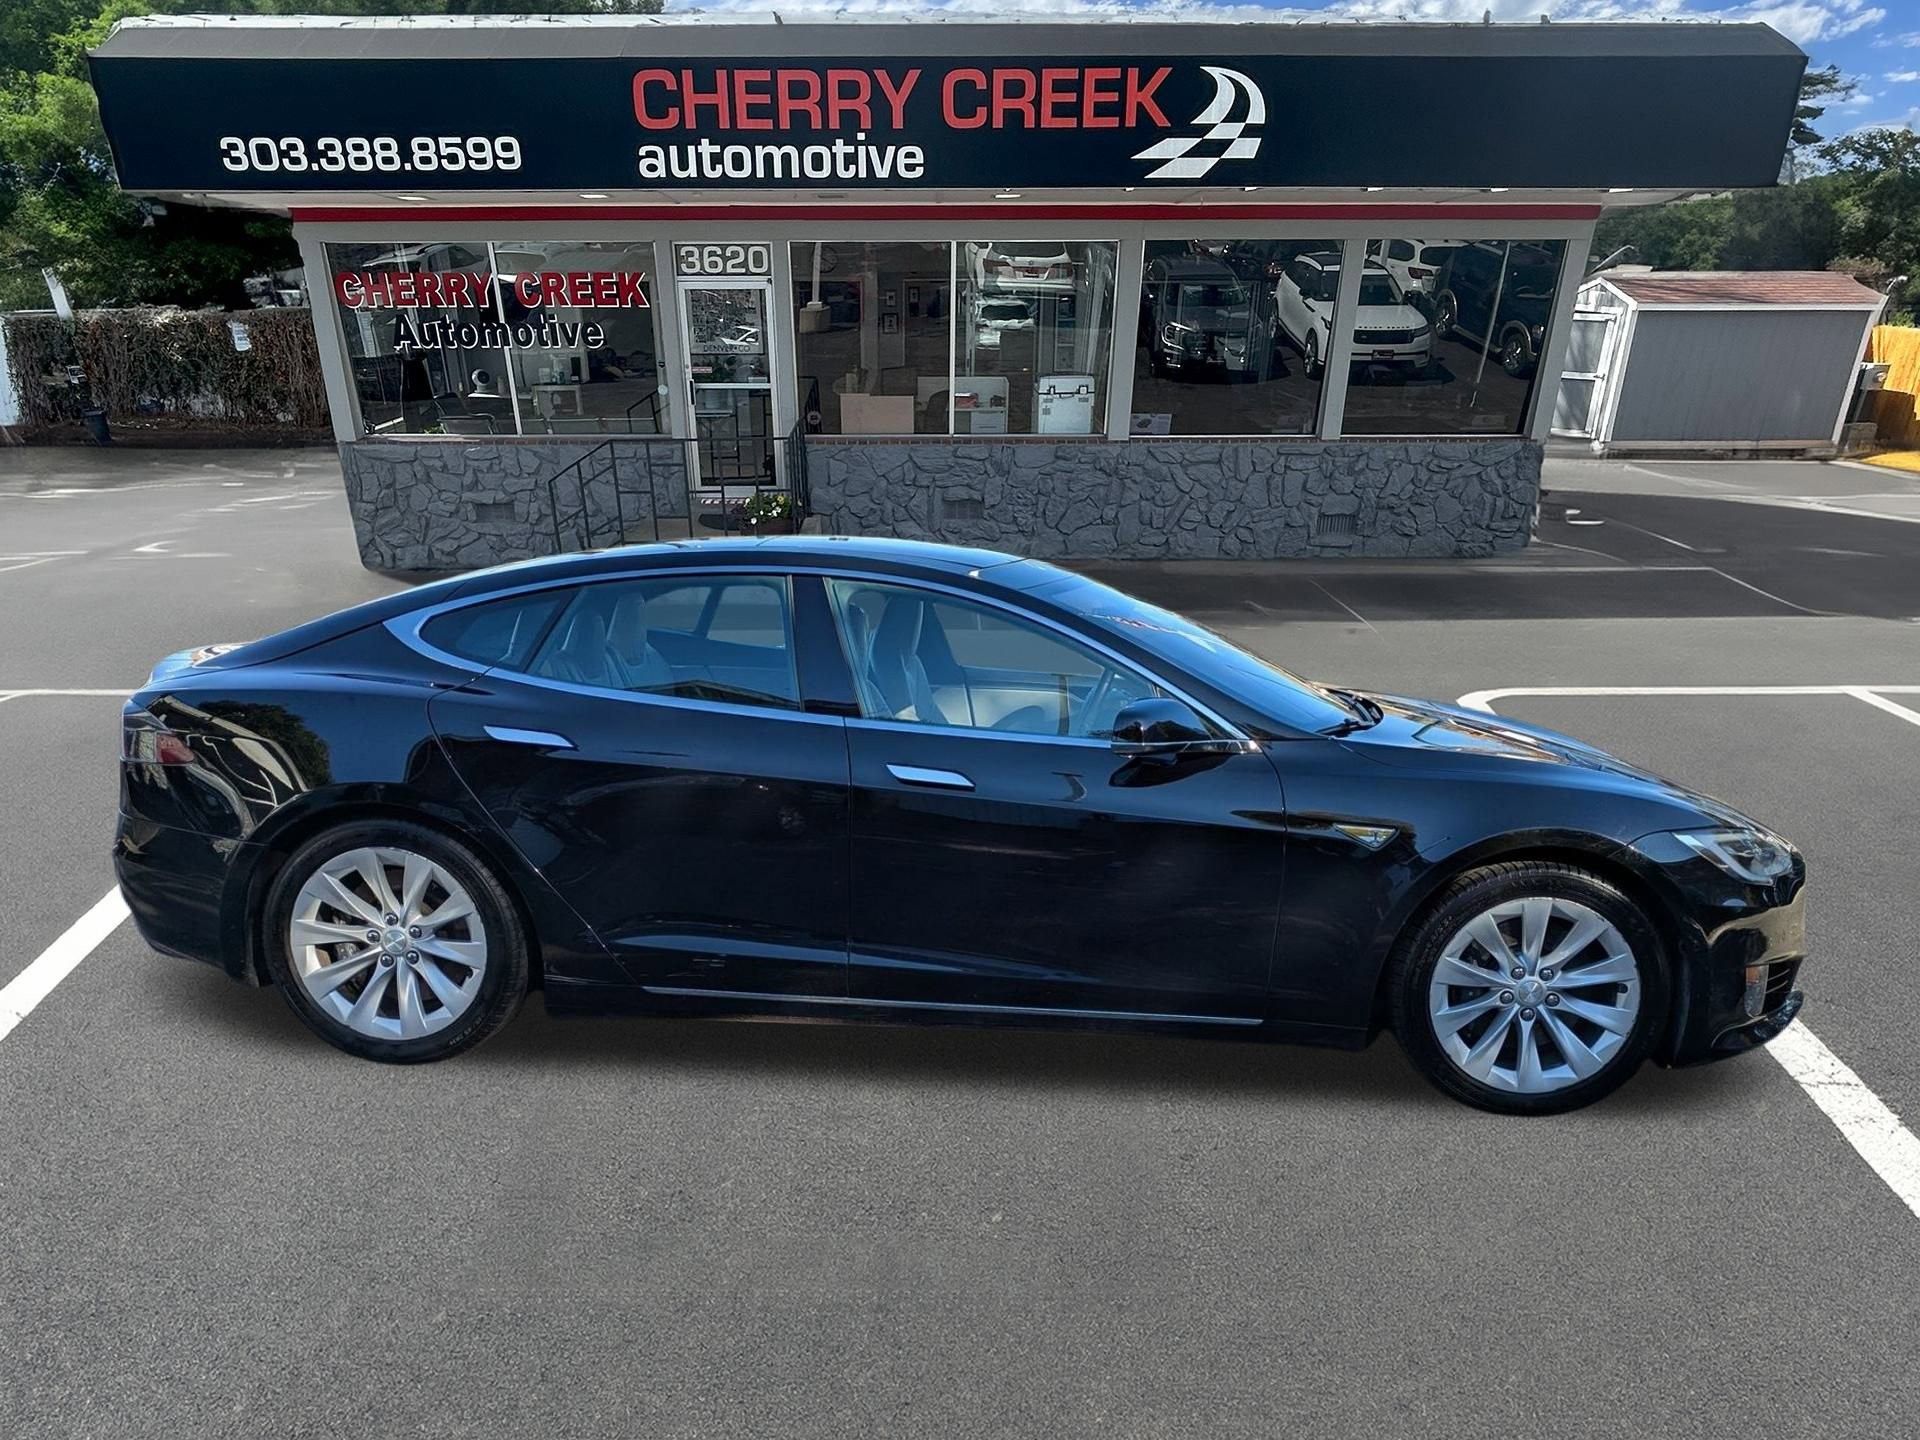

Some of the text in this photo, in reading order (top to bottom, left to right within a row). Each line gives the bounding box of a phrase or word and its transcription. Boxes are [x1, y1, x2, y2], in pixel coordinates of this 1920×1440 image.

[632, 67, 1172, 130] CHERRY CREEK
[219, 136, 522, 172] 303.388.8599
[638, 132, 924, 179] automotive
[680, 246, 768, 273] 3620
[334, 271, 650, 309] CHERRY CREEK
[393, 313, 606, 351] Automotive
